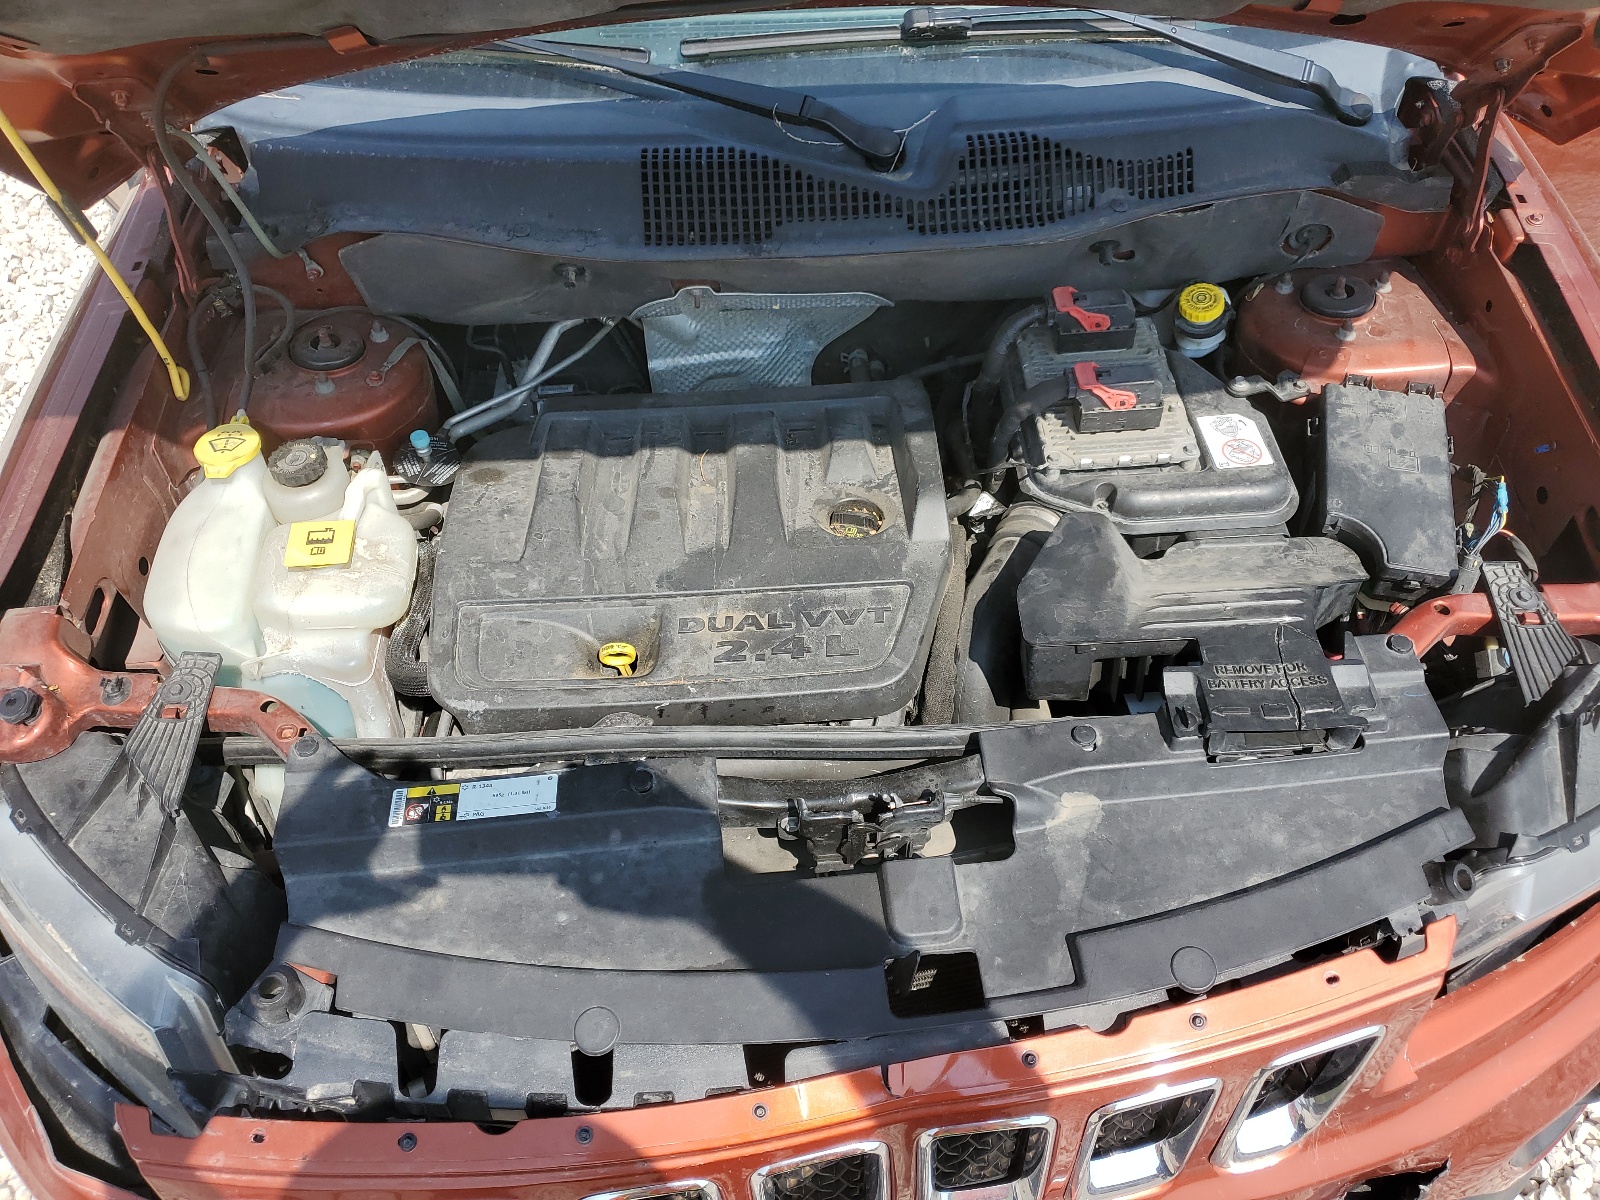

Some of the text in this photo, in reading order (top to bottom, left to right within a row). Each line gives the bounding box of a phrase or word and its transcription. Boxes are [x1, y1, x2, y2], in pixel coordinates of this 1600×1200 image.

[677, 606, 892, 635] DUAL VVT
[1213, 662, 1308, 676] REMOVE FOR
[1207, 674, 1329, 690] BATTERY ACCESS
